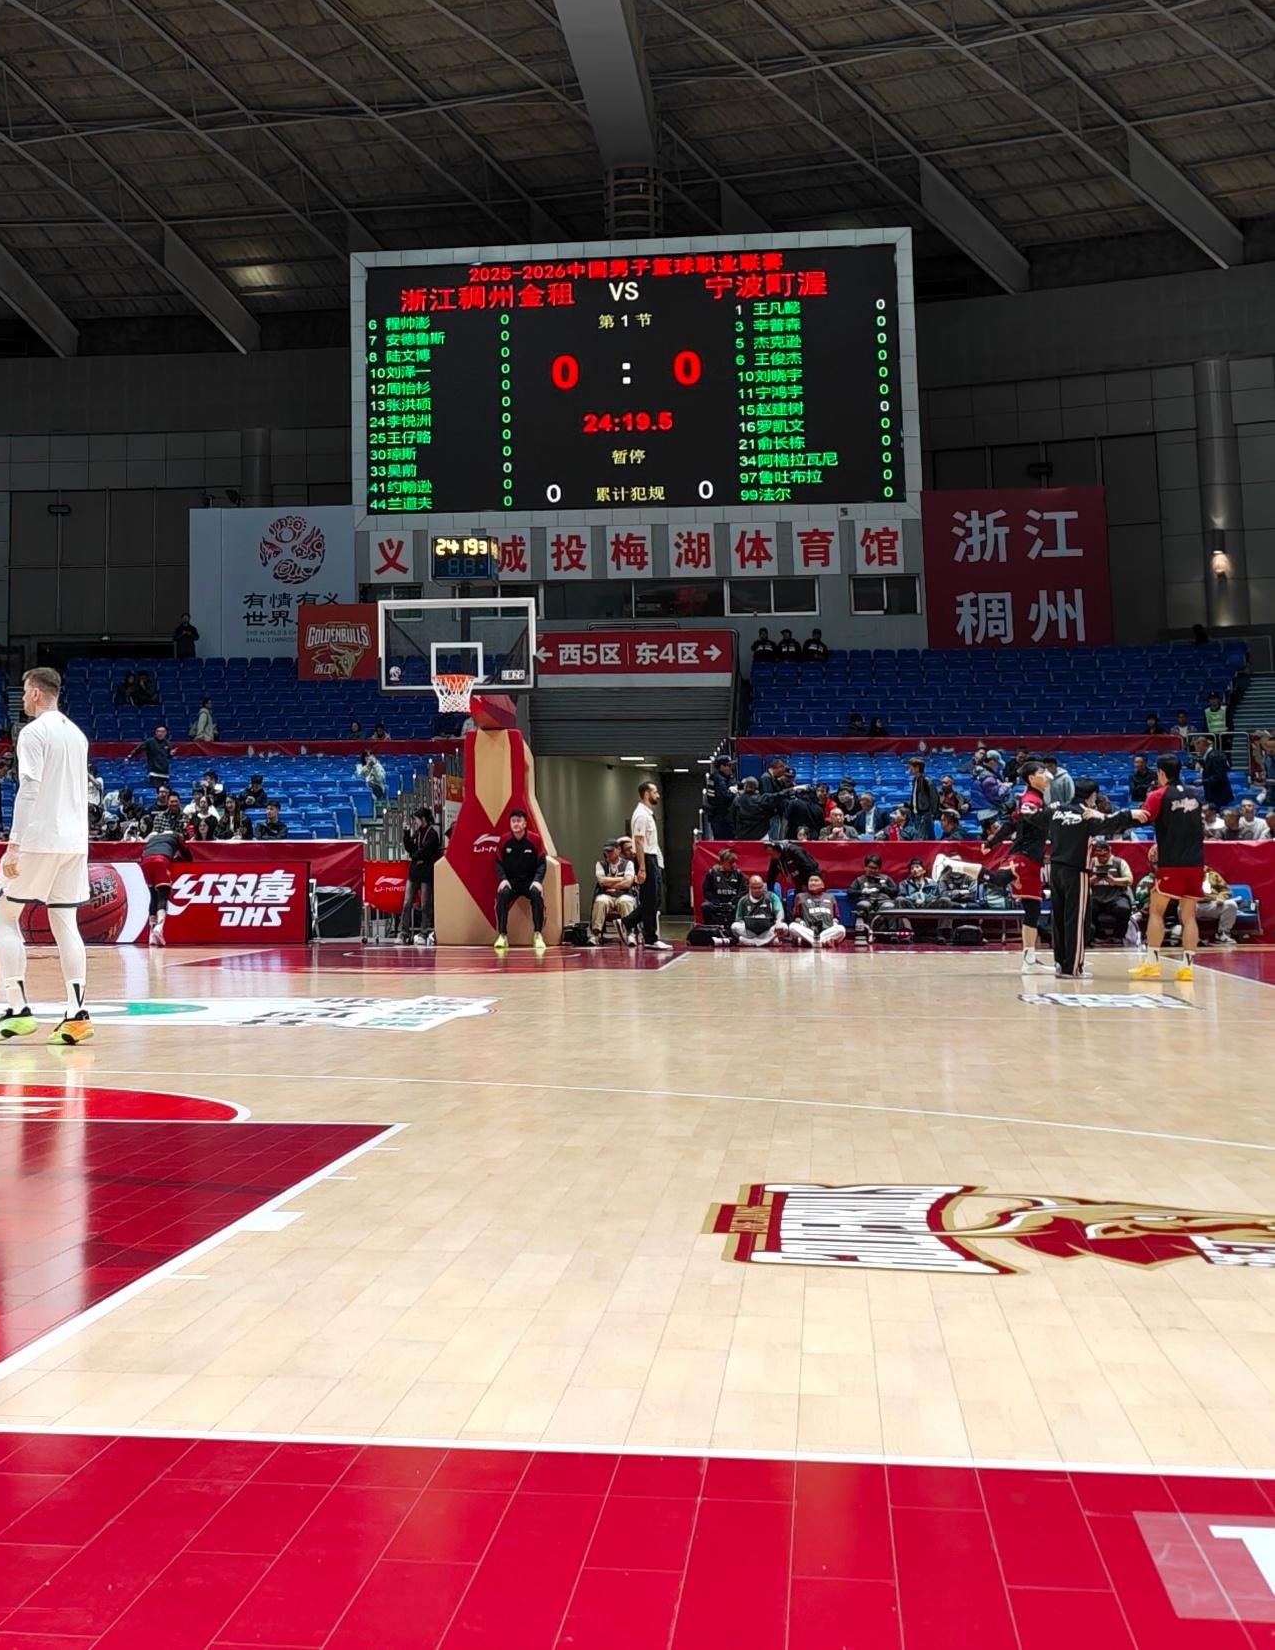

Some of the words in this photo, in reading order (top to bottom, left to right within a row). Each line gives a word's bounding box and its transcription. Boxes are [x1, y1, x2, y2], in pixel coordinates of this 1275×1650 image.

[609, 281, 640, 302] VS
[705, 271, 828, 299] 宁波町渥
[400, 282, 575, 313] 浙江稠州金租
[735, 305, 741, 316] 1
[876, 299, 886, 310] 0
[368, 319, 377, 330] 6
[500, 314, 509, 325] 0
[735, 321, 744, 332] 3
[753, 318, 801, 332] 辛普森
[876, 316, 886, 327] 0
[369, 335, 376, 346] 7
[386, 331, 446, 347] 安德鲁斯
[500, 330, 509, 341] 0
[735, 338, 744, 349] 5
[753, 335, 802, 349] 杰克逊
[877, 333, 887, 343] 0
[369, 352, 377, 363] 8
[501, 347, 510, 357] 0
[735, 355, 745, 365] 6
[754, 352, 802, 366] 王俊杰
[878, 350, 887, 360] 0
[370, 368, 385, 379] 10
[501, 363, 510, 374] 0
[552, 354, 579, 390] 0
[673, 350, 702, 386] 0
[738, 372, 754, 382] 10
[755, 369, 803, 382] 刘晓宇
[878, 366, 888, 377] 0
[370, 385, 385, 395] 12
[501, 380, 510, 390] 0
[738, 388, 753, 399] 11
[879, 384, 889, 395] 0
[370, 401, 385, 411] 13
[502, 396, 511, 407] 0
[738, 405, 755, 416] 15
[880, 401, 889, 412] 0
[369, 417, 385, 428] 24
[502, 412, 511, 423] 0
[583, 411, 673, 433] 24:19.5
[739, 422, 756, 433] 16
[757, 419, 805, 433] 罗凯文
[881, 418, 891, 429] 0
[369, 433, 386, 444] 25
[502, 429, 511, 440] 0
[739, 439, 755, 450] 21
[881, 435, 891, 446] 0
[369, 450, 386, 460] 30
[502, 446, 511, 456] 0
[612, 449, 646, 465] 暂停
[739, 456, 756, 467] 34
[882, 452, 892, 463] 0
[370, 466, 386, 476] 33
[503, 462, 512, 473] 0
[740, 473, 757, 483] 97
[883, 469, 893, 480] 0
[369, 483, 385, 493] 41
[387, 480, 433, 494] 约翰逊
[503, 479, 512, 489] 0
[546, 484, 562, 503] 0
[596, 486, 666, 502] 累计犯规
[698, 480, 714, 499] 0
[740, 490, 758, 500] 99
[759, 488, 792, 501] 法尔
[884, 486, 893, 497] 0
[369, 499, 386, 509] 44
[387, 497, 433, 511] 兰道夫
[504, 496, 513, 507] 0
[951, 508, 1084, 563] 浙江
[374, 526, 900, 576] 义城投梅湖体育馆
[243, 611, 299, 628] 世界
[955, 588, 1086, 645] 稠州
[307, 626, 369, 647] GOLDENBULLS
[558, 643, 621, 666] 西5区
[635, 642, 699, 665] 东4区
[167, 869, 296, 916] 红双喜
[218, 906, 291, 927] DHS
